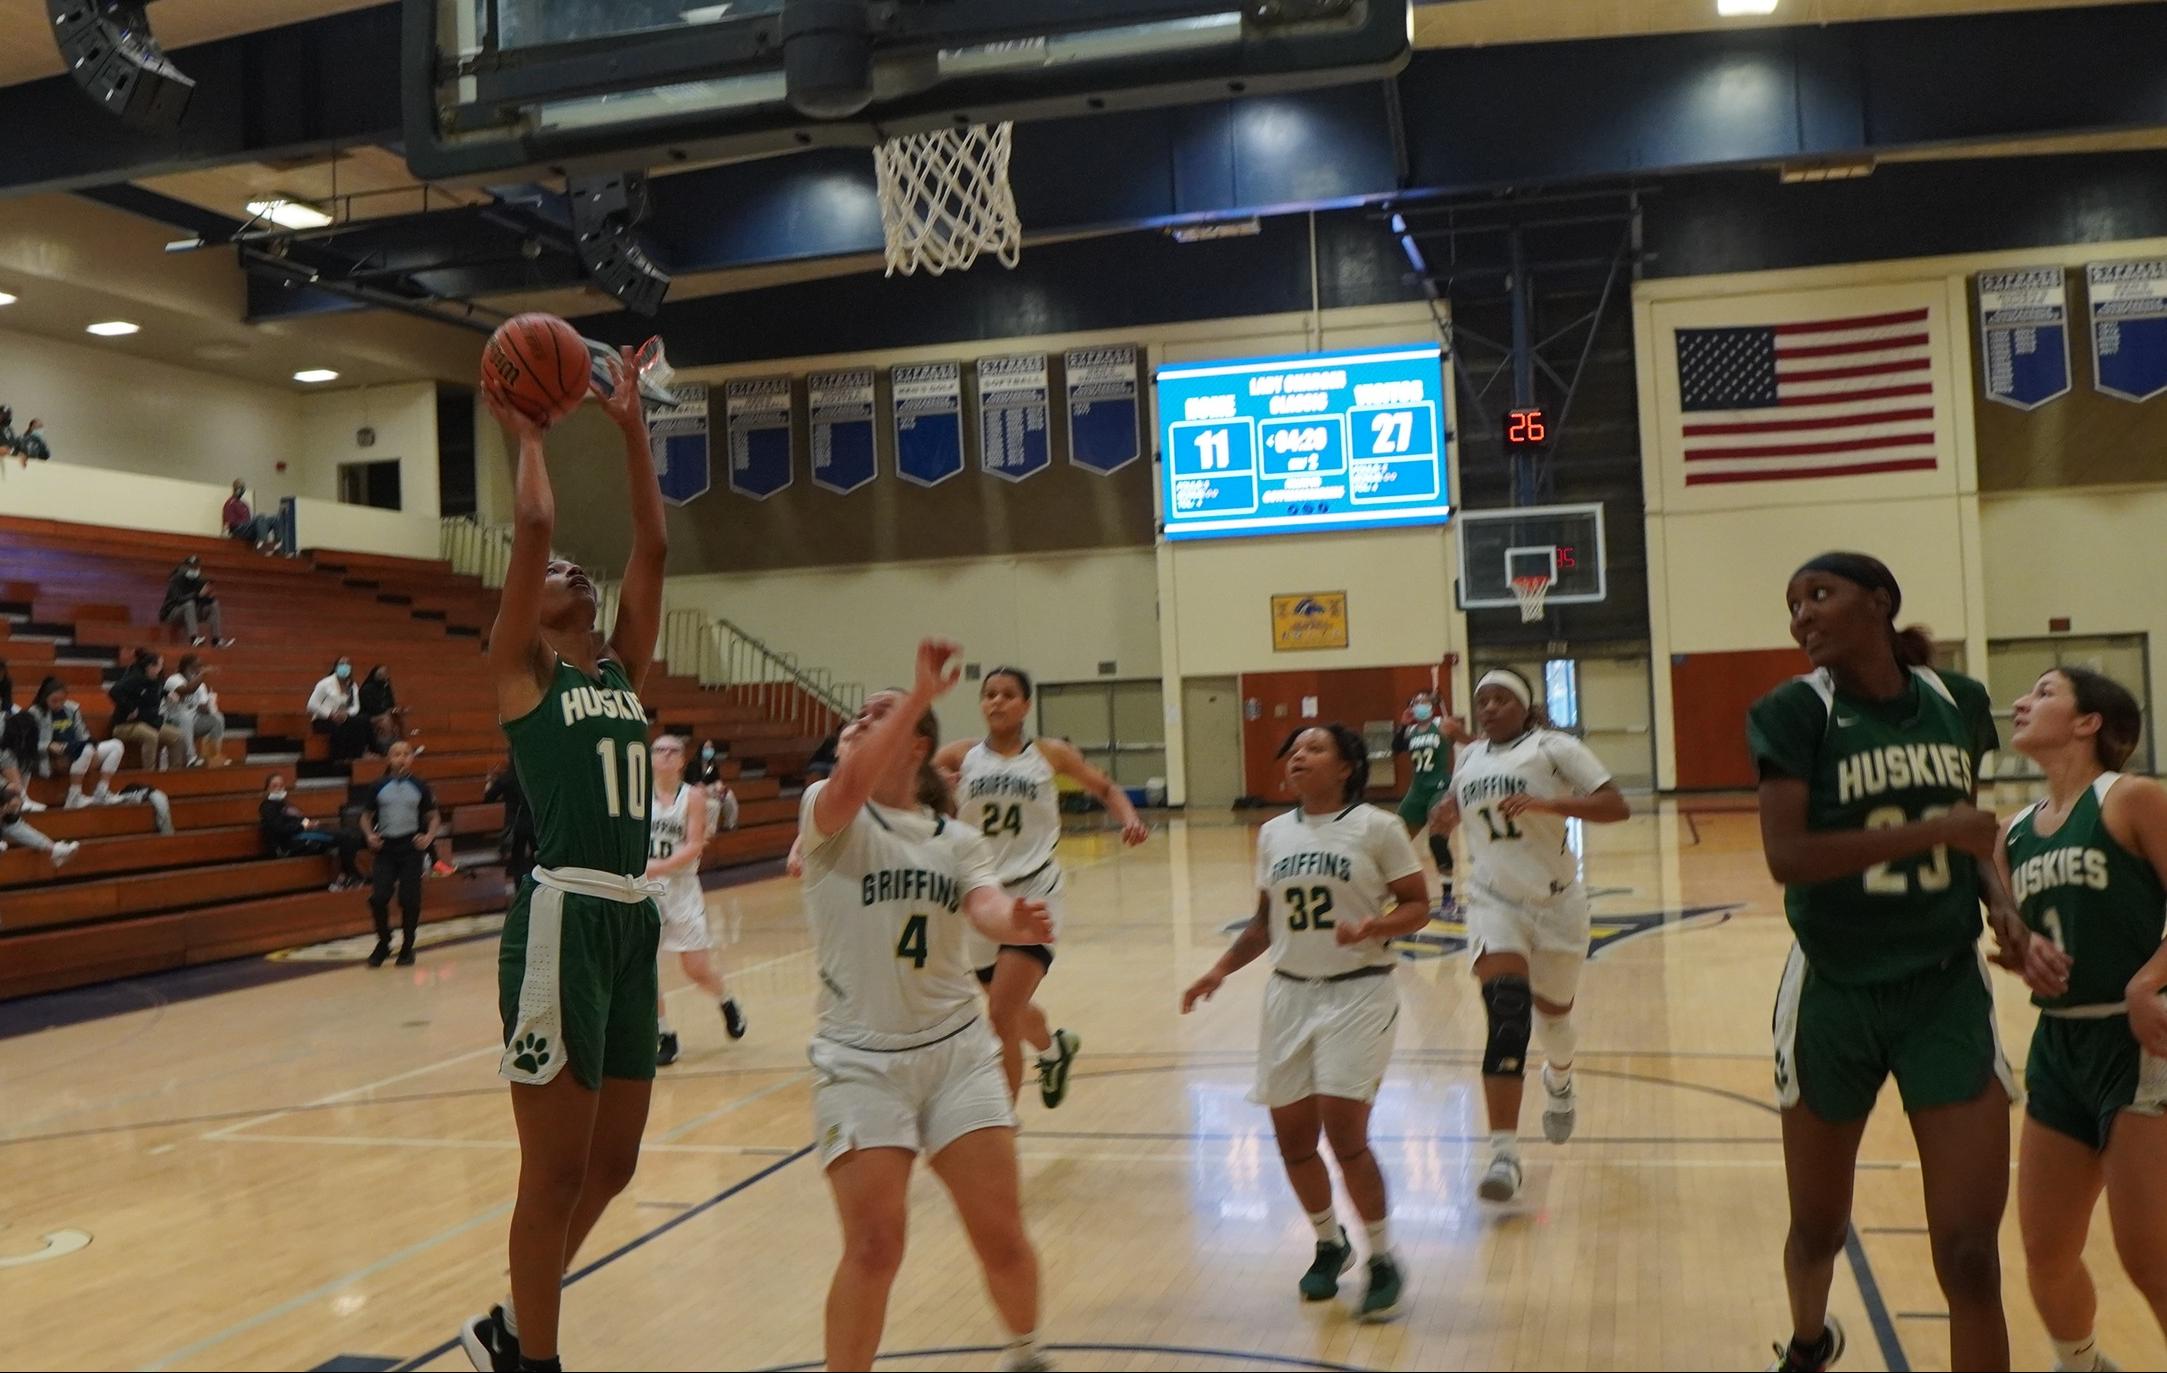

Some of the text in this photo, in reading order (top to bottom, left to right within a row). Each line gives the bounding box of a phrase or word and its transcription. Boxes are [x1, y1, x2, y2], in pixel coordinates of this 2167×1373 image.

[1194, 428, 1230, 470] 11
[1371, 411, 1414, 454] 27
[1510, 412, 1545, 442] 26
[596, 737, 646, 820] 10
[1838, 743, 1972, 804] HUSKIES
[983, 802, 1021, 838] 24
[2012, 845, 2110, 911] USKIES
[1285, 885, 1335, 931] 32
[896, 914, 928, 969] 4
